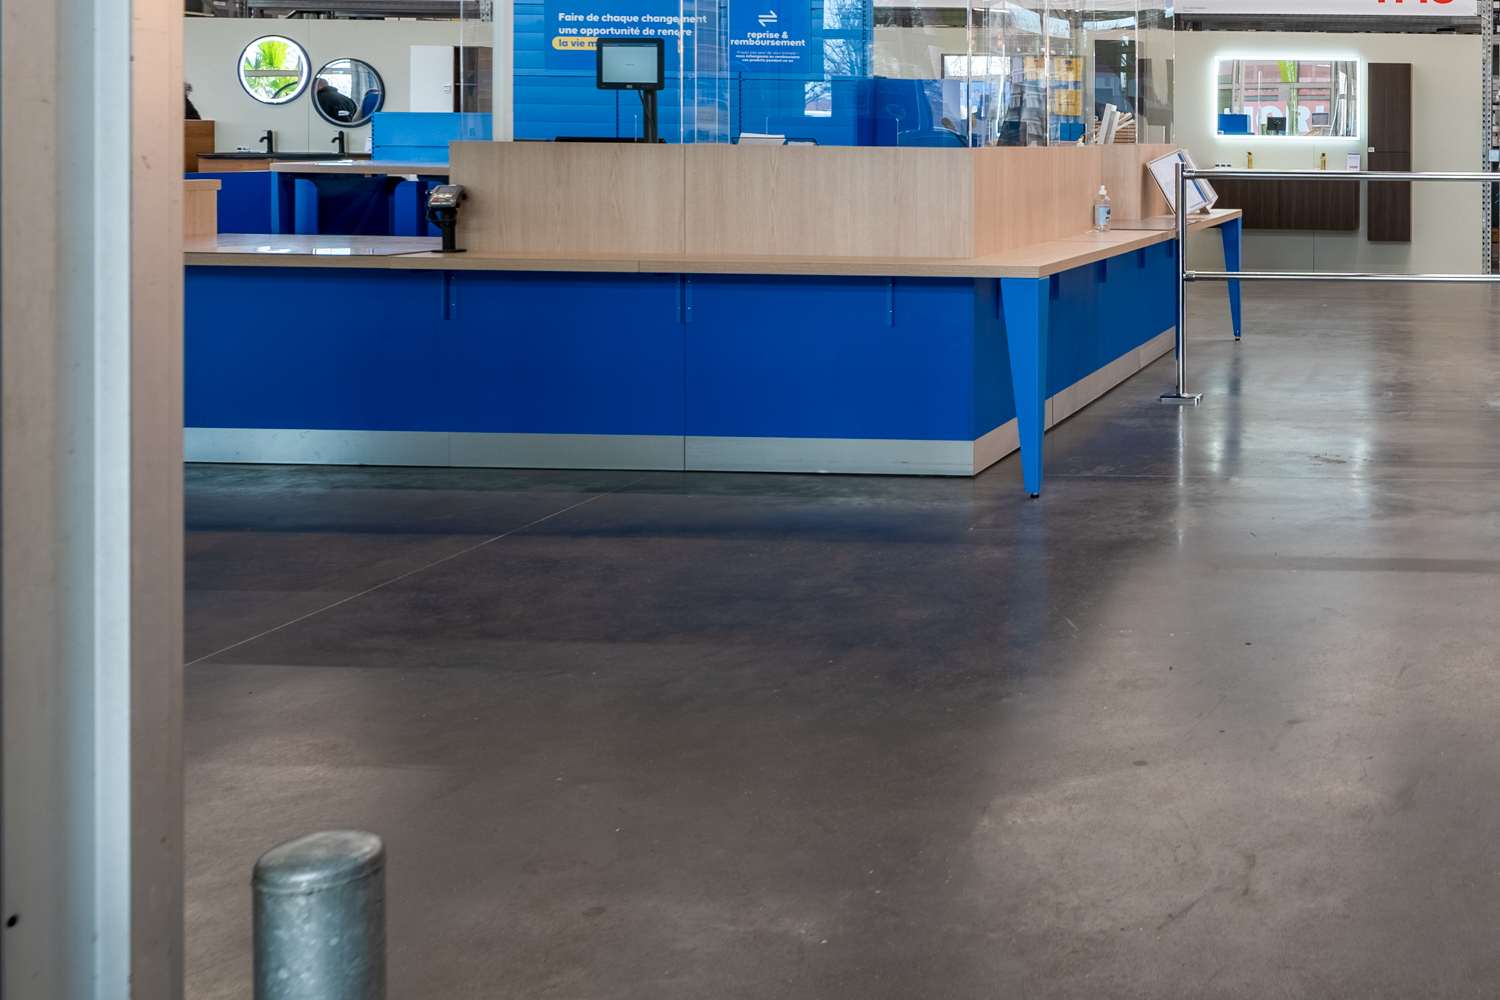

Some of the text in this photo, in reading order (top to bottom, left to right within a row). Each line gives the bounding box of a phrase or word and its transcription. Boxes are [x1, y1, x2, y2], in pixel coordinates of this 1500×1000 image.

[558, 12, 707, 26] Faire de chaque changement
[558, 27, 580, 36] une
[581, 25, 640, 39] opportunité
[642, 26, 656, 36] de
[747, 30, 788, 40] reprise &
[558, 38, 569, 48] la
[570, 38, 586, 48] vie
[730, 38, 806, 47] remboursement
